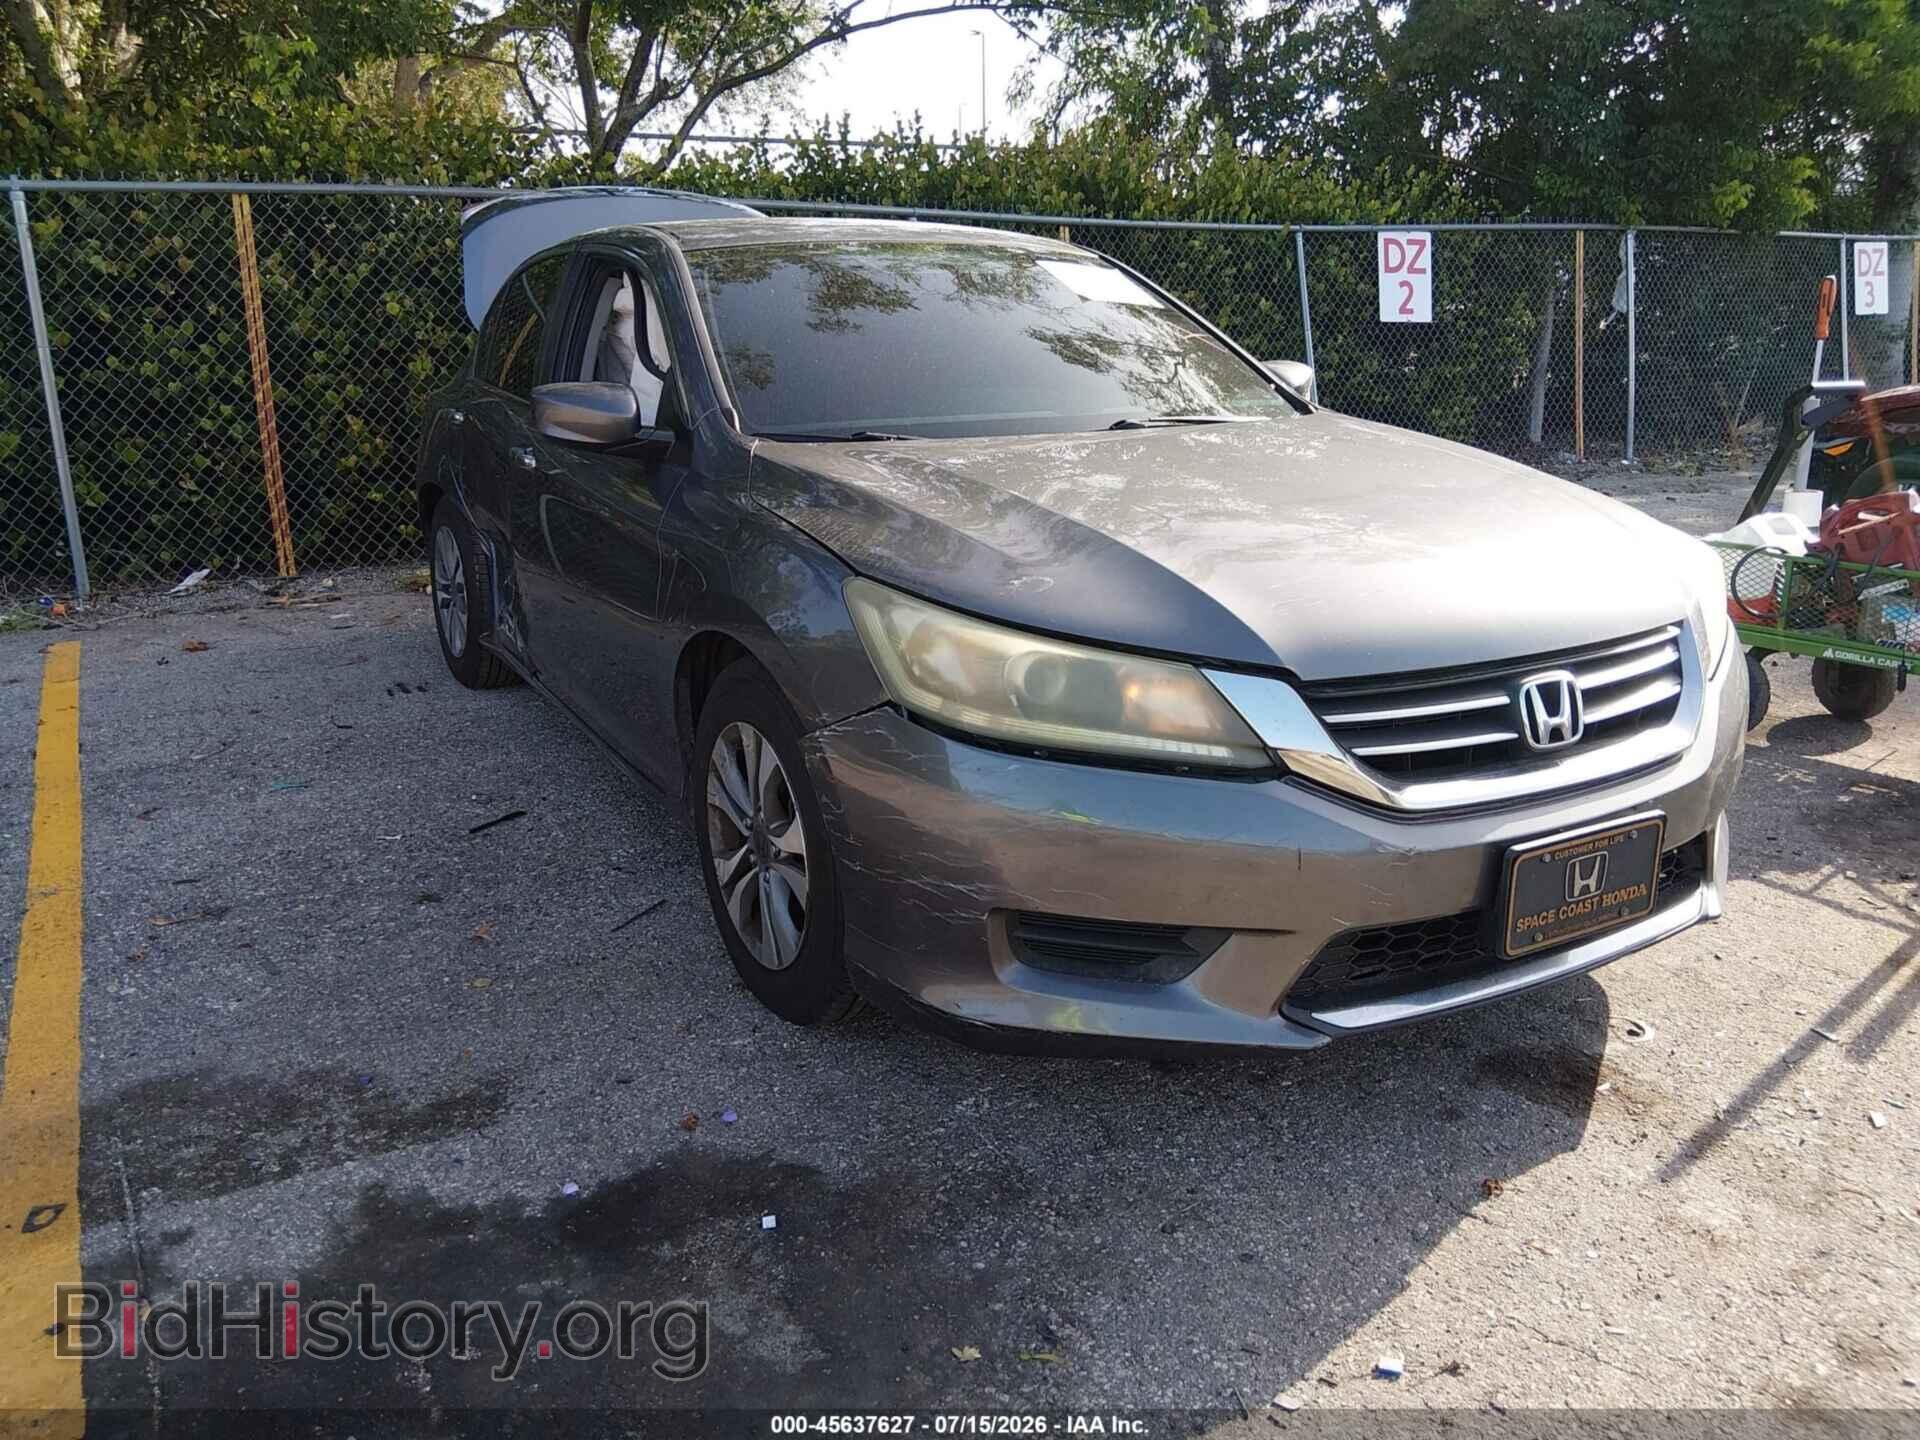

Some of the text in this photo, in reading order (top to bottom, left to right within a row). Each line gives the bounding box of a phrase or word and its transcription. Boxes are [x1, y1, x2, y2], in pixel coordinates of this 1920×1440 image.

[1383, 238, 1427, 275] DZ
[1857, 248, 1885, 277] DZ
[1398, 280, 1414, 315] 2
[1864, 281, 1876, 308] 3
[1516, 908, 1557, 932] SPACE
[1559, 896, 1600, 920] COAST
[1601, 883, 1648, 907] HONDA
